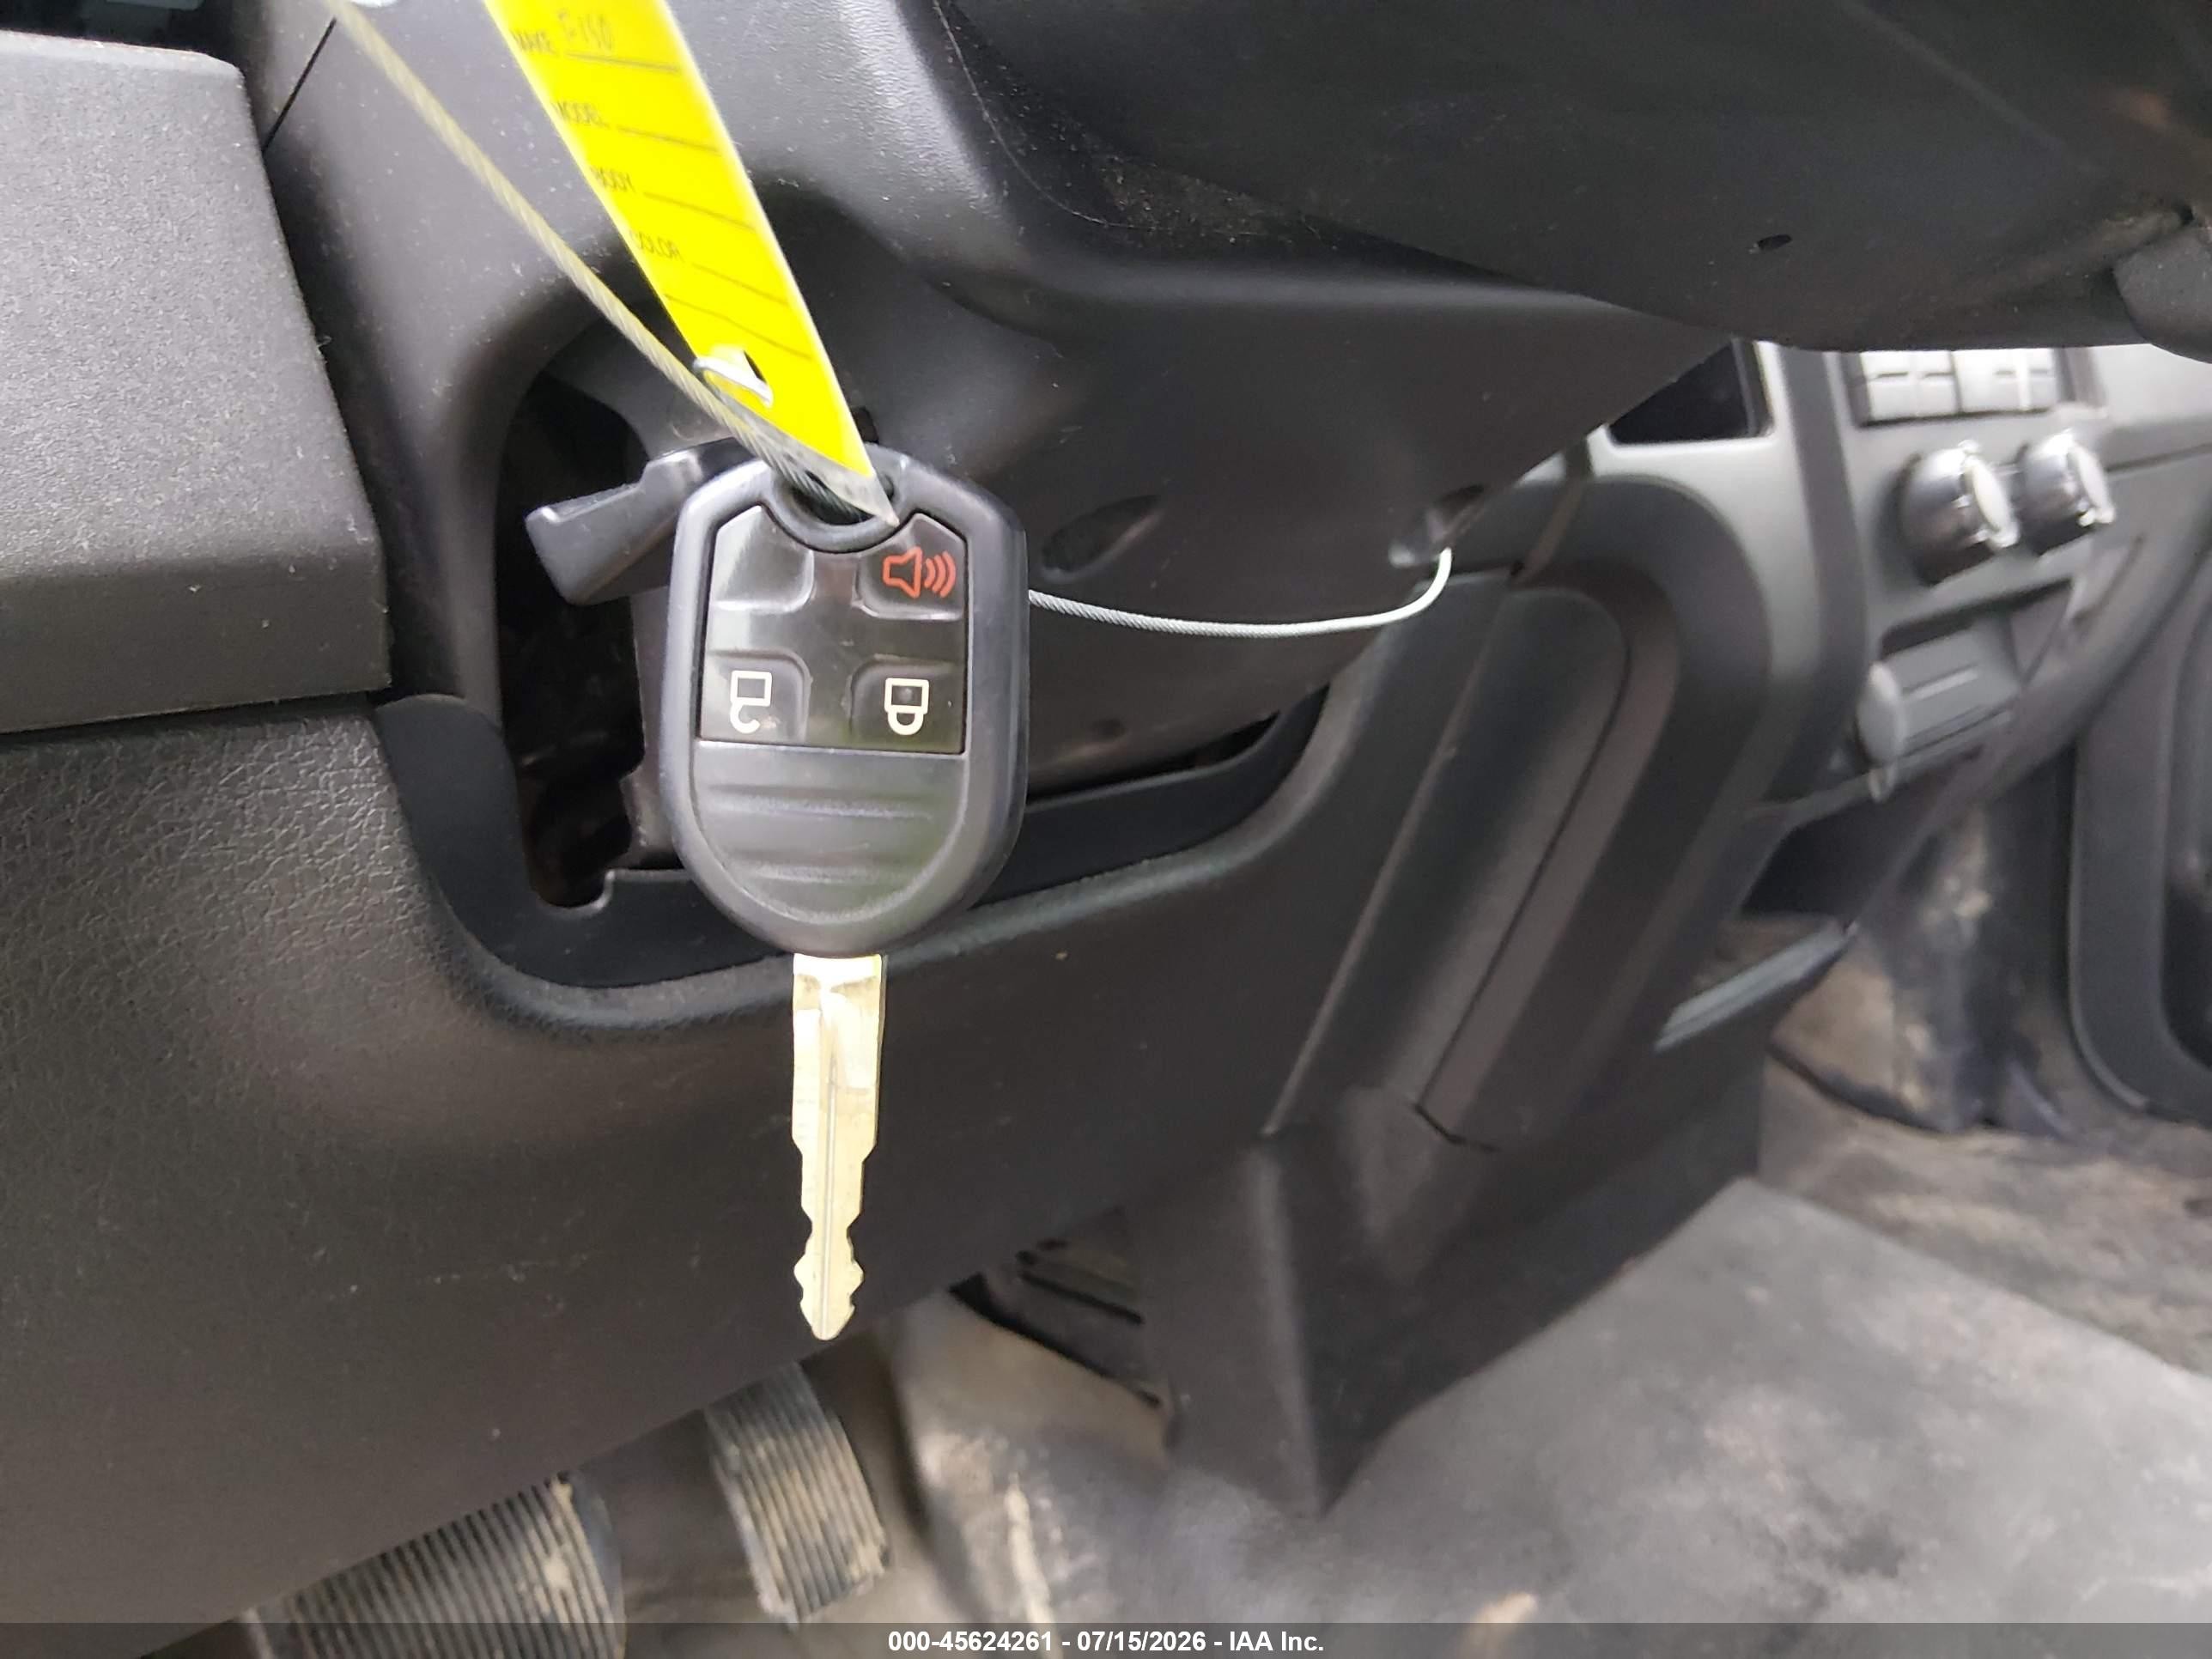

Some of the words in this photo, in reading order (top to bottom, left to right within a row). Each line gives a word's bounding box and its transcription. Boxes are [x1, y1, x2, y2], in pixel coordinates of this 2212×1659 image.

[512, 28, 559, 56] MAKE
[551, 100, 609, 129] MODEL
[590, 166, 635, 193] BODY
[629, 229, 684, 261] COLOR
